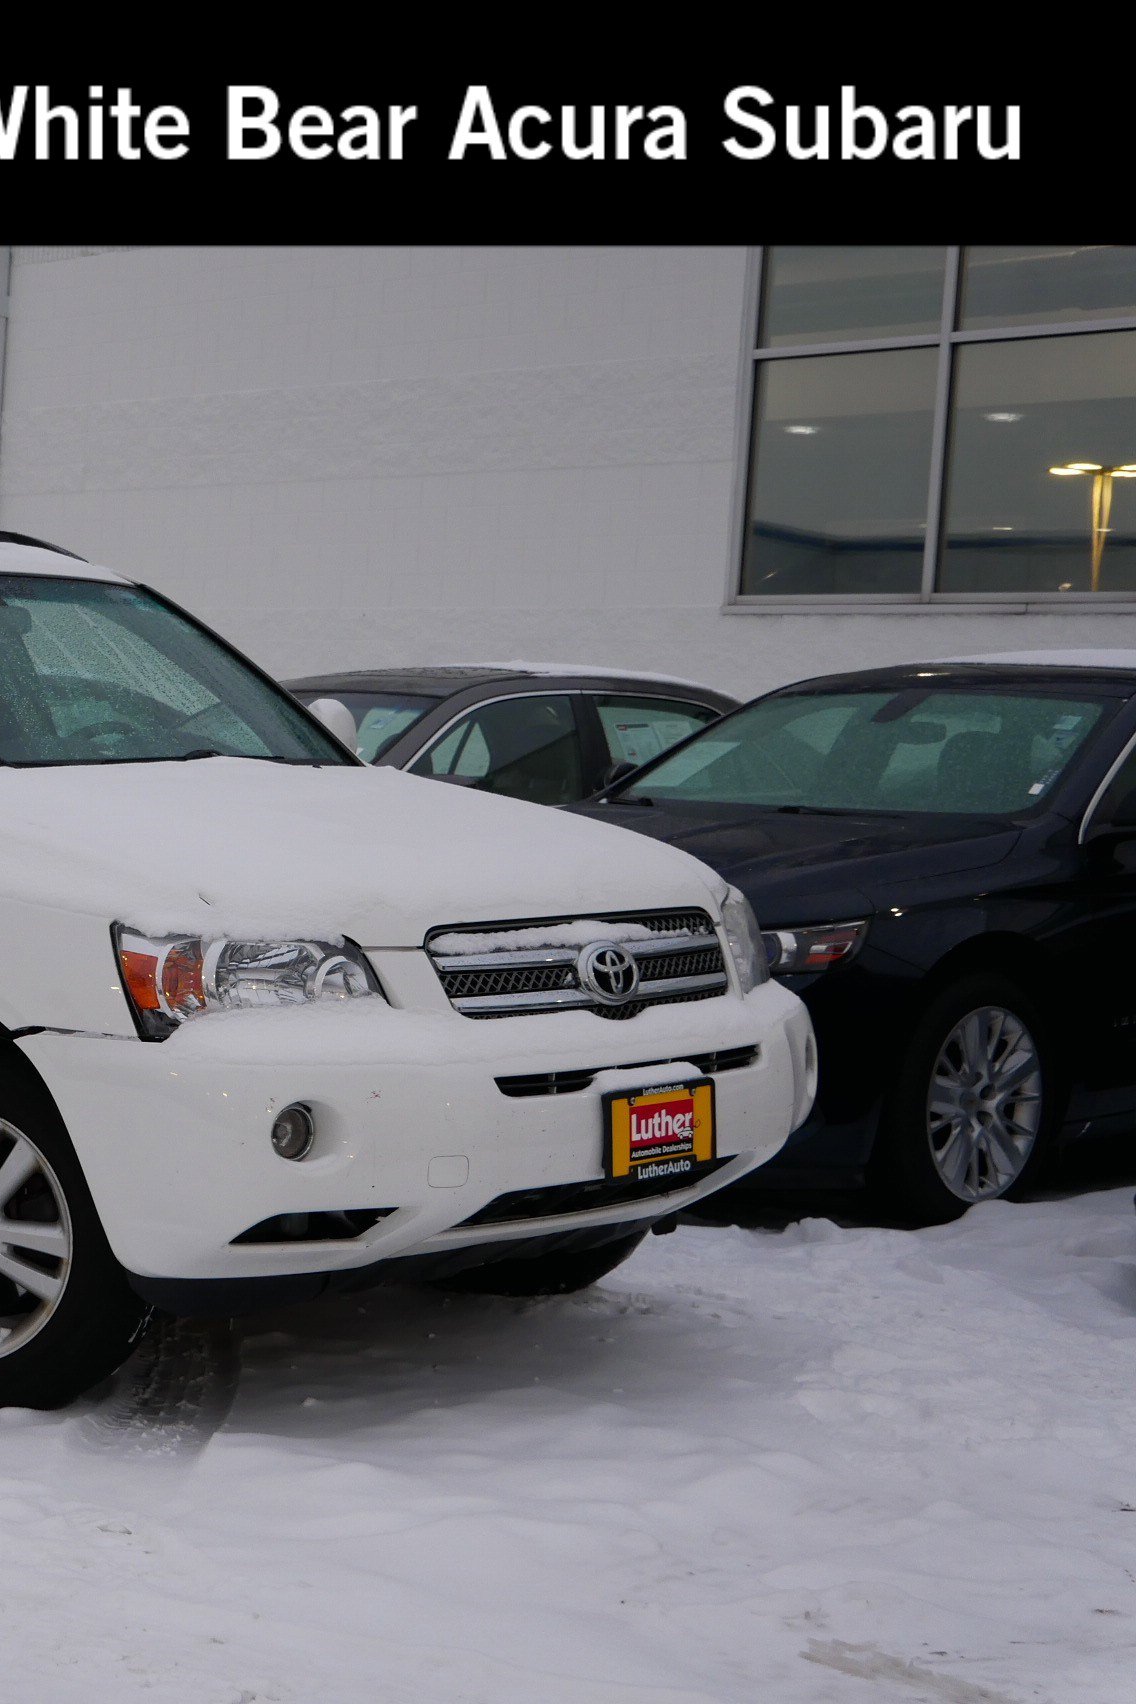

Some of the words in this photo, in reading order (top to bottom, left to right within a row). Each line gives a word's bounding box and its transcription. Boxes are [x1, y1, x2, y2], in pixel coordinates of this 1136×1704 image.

[642, 1084, 684, 1096] LutherAuto.com
[631, 1109, 693, 1142] Luther
[631, 1147, 662, 1158] Automobile
[662, 1142, 692, 1153] Dealerships
[637, 1160, 691, 1179] LutherAuto
